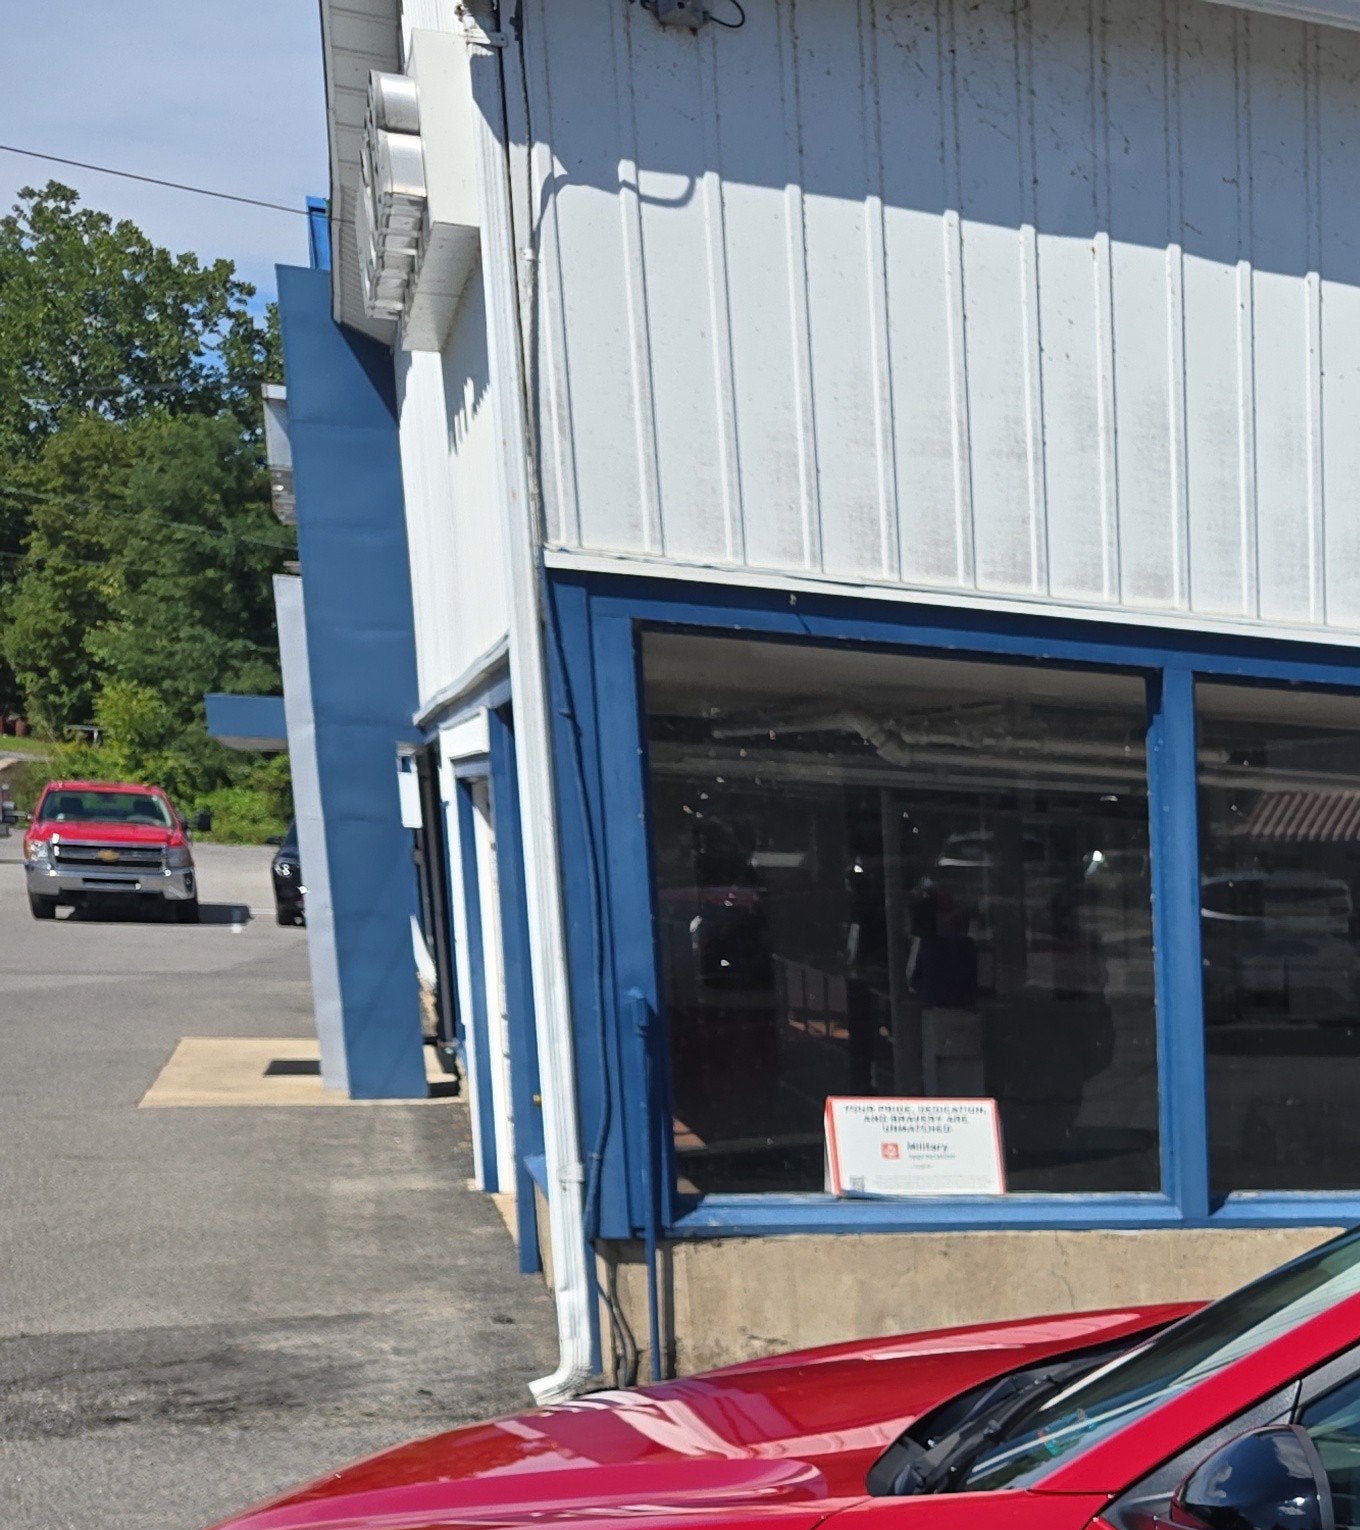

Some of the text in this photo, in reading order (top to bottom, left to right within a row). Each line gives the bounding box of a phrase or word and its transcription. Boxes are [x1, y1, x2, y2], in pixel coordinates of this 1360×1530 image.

[843, 1105, 874, 1114] YOUR
[863, 1115, 887, 1123] AND
[890, 1115, 942, 1123] BRAVERY
[906, 1142, 948, 1152] Military
